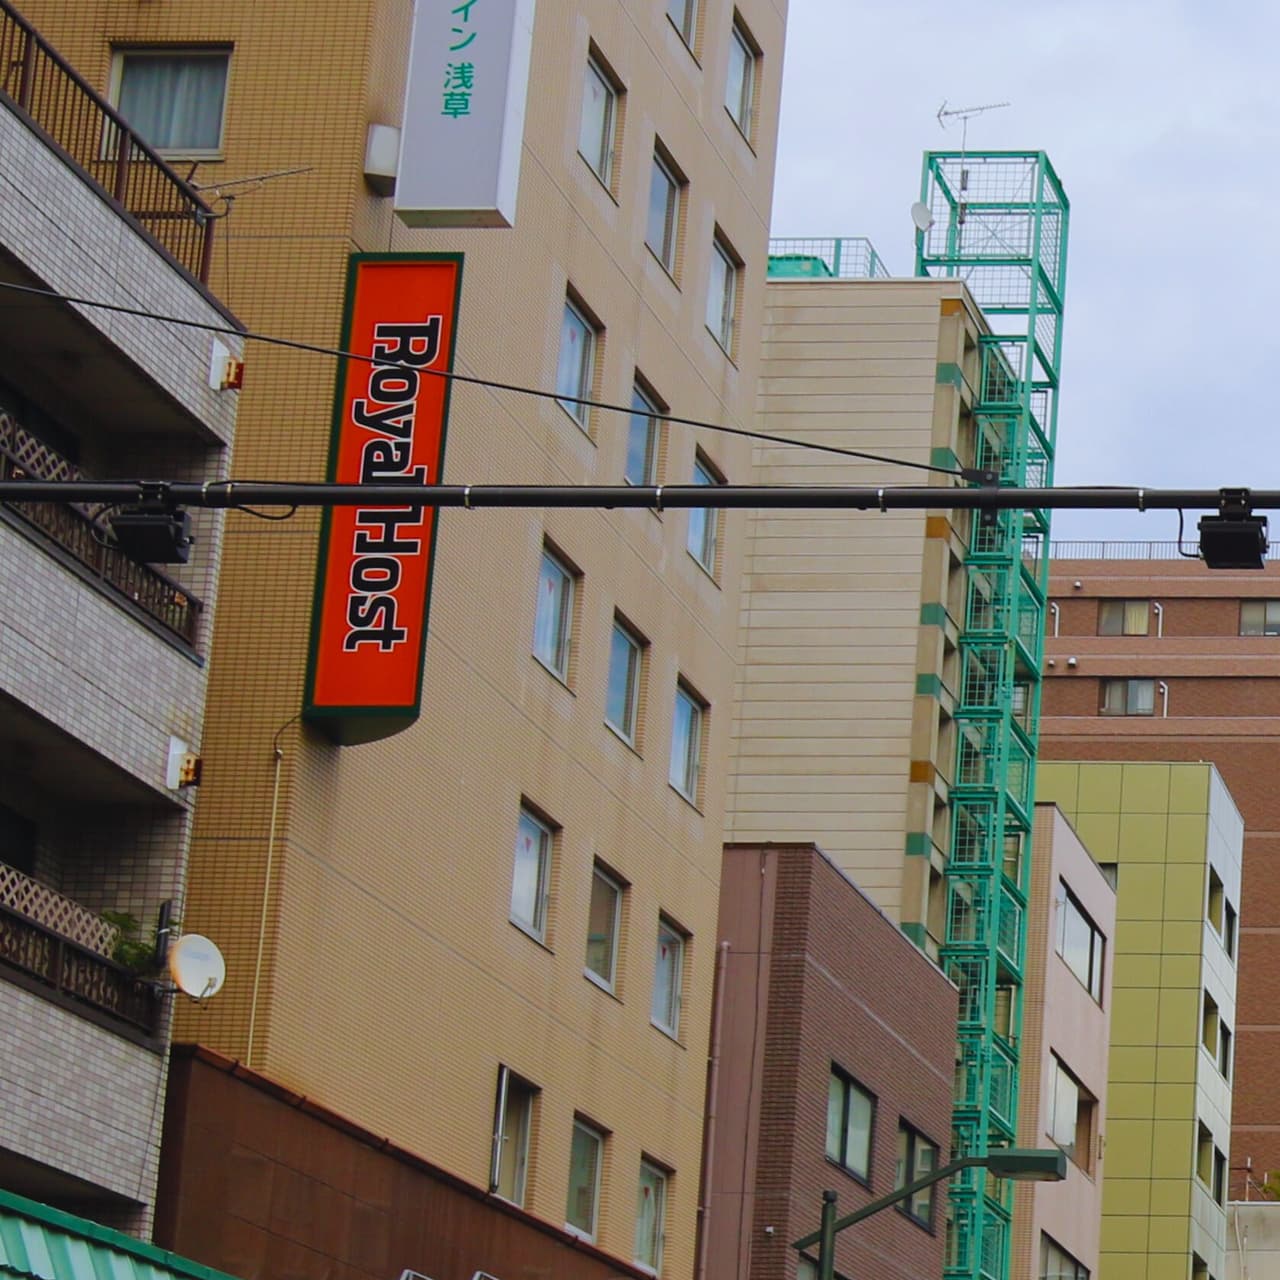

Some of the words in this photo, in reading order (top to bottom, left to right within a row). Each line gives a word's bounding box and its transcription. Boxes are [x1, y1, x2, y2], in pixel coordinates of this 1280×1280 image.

[441, 62, 475, 118] 浅草
[352, 316, 441, 486] Royal
[343, 504, 424, 652] Host
